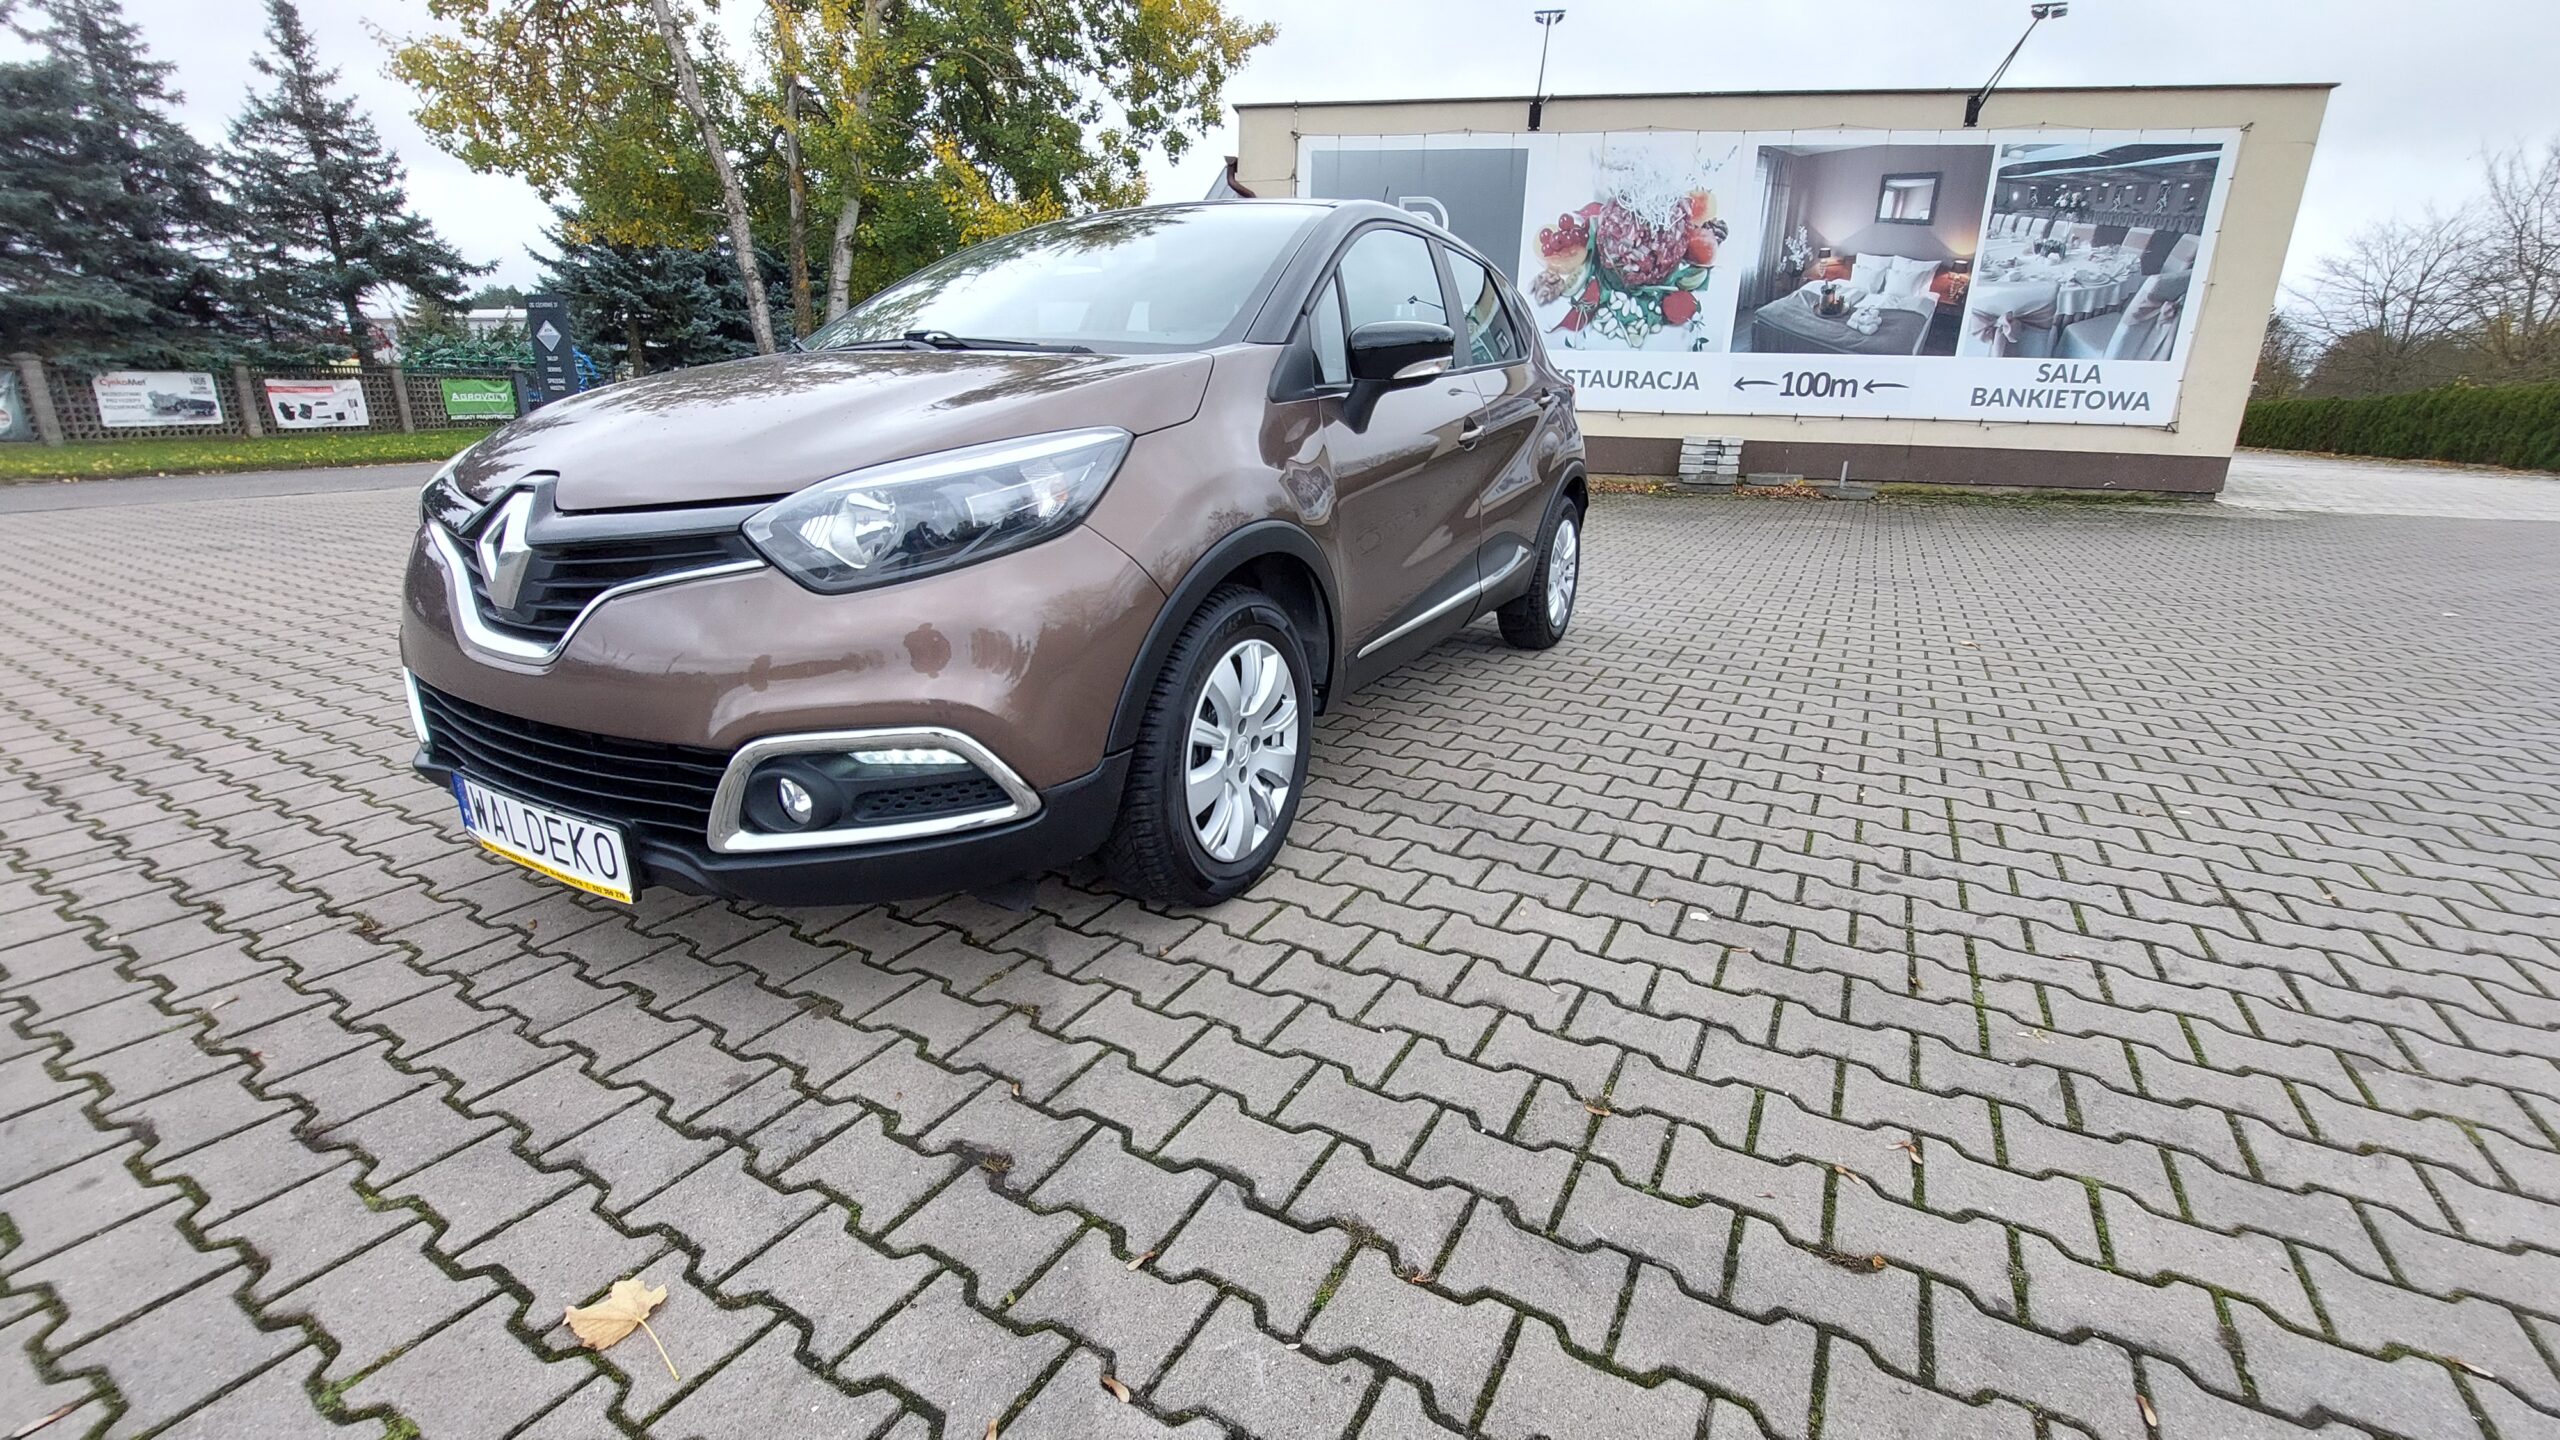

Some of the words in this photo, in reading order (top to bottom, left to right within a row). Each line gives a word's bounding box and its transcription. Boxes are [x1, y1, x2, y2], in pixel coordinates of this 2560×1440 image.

[1556, 369, 1700, 390] STAURACJA
[1779, 371, 1859, 398] 100m
[2035, 363, 2102, 384] SALA
[1970, 387, 2151, 411] BANKIETOWA
[469, 786, 619, 880] WALDEKO
